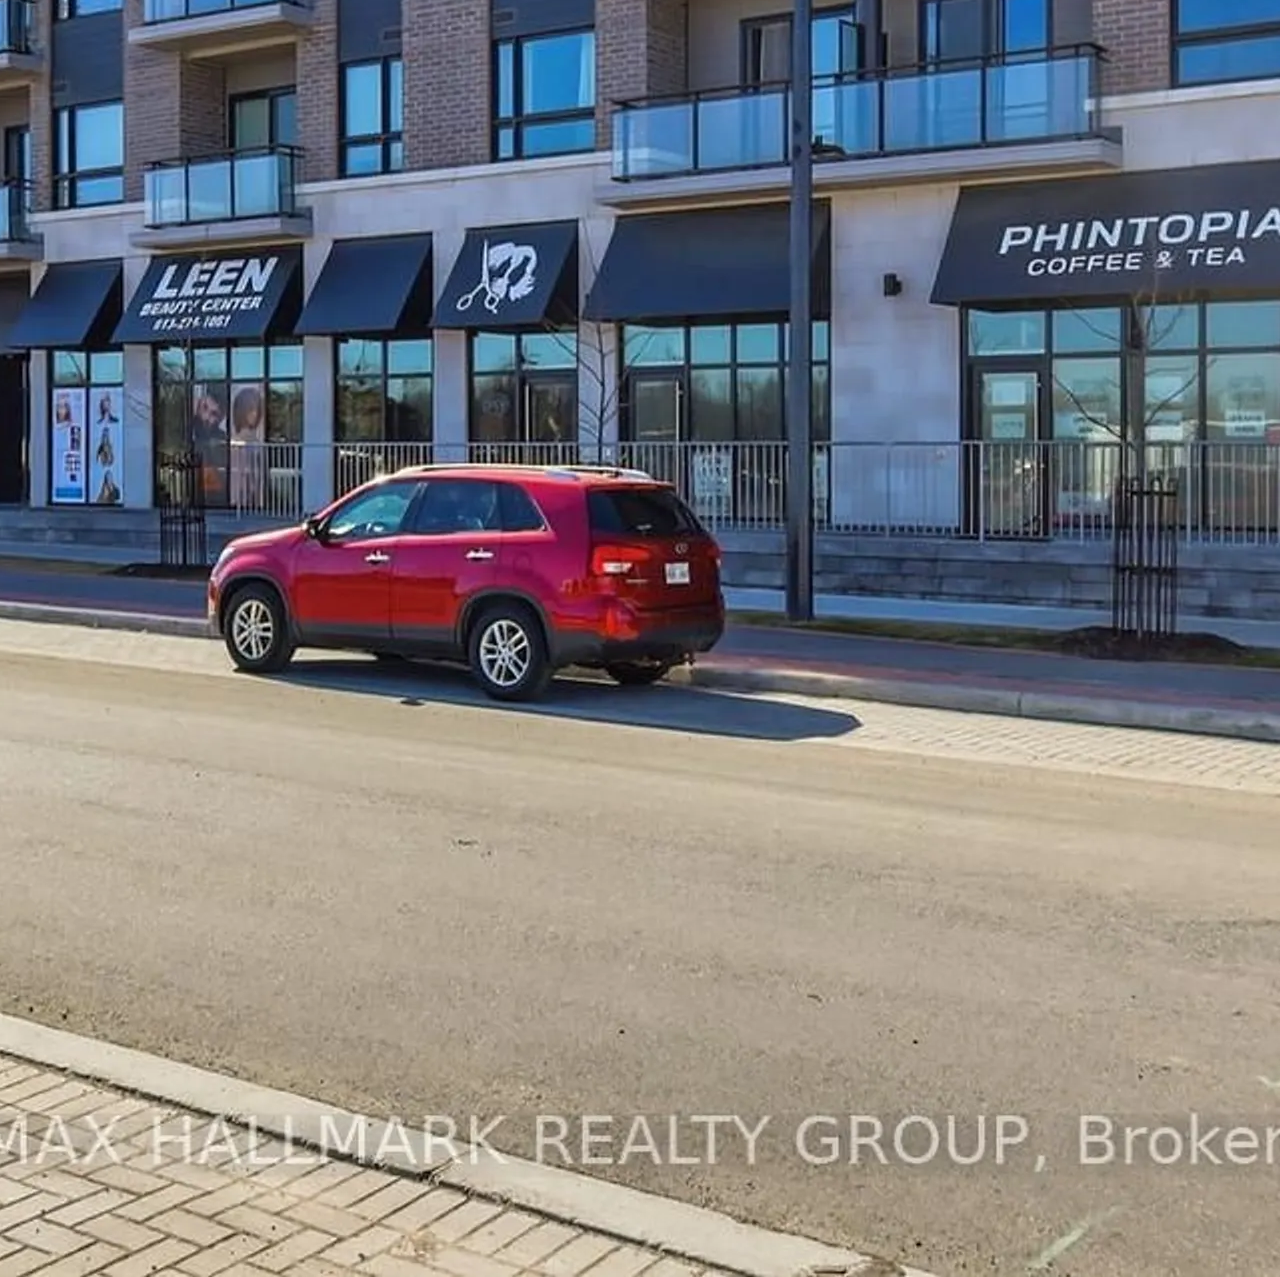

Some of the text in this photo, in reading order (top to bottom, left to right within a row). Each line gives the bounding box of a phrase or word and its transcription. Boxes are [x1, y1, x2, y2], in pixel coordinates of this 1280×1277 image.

[1027, 247, 1246, 276] COFFEE & TEA
[152, 257, 279, 299] LEEN
[139, 296, 263, 317] BEAUTY CENTER
